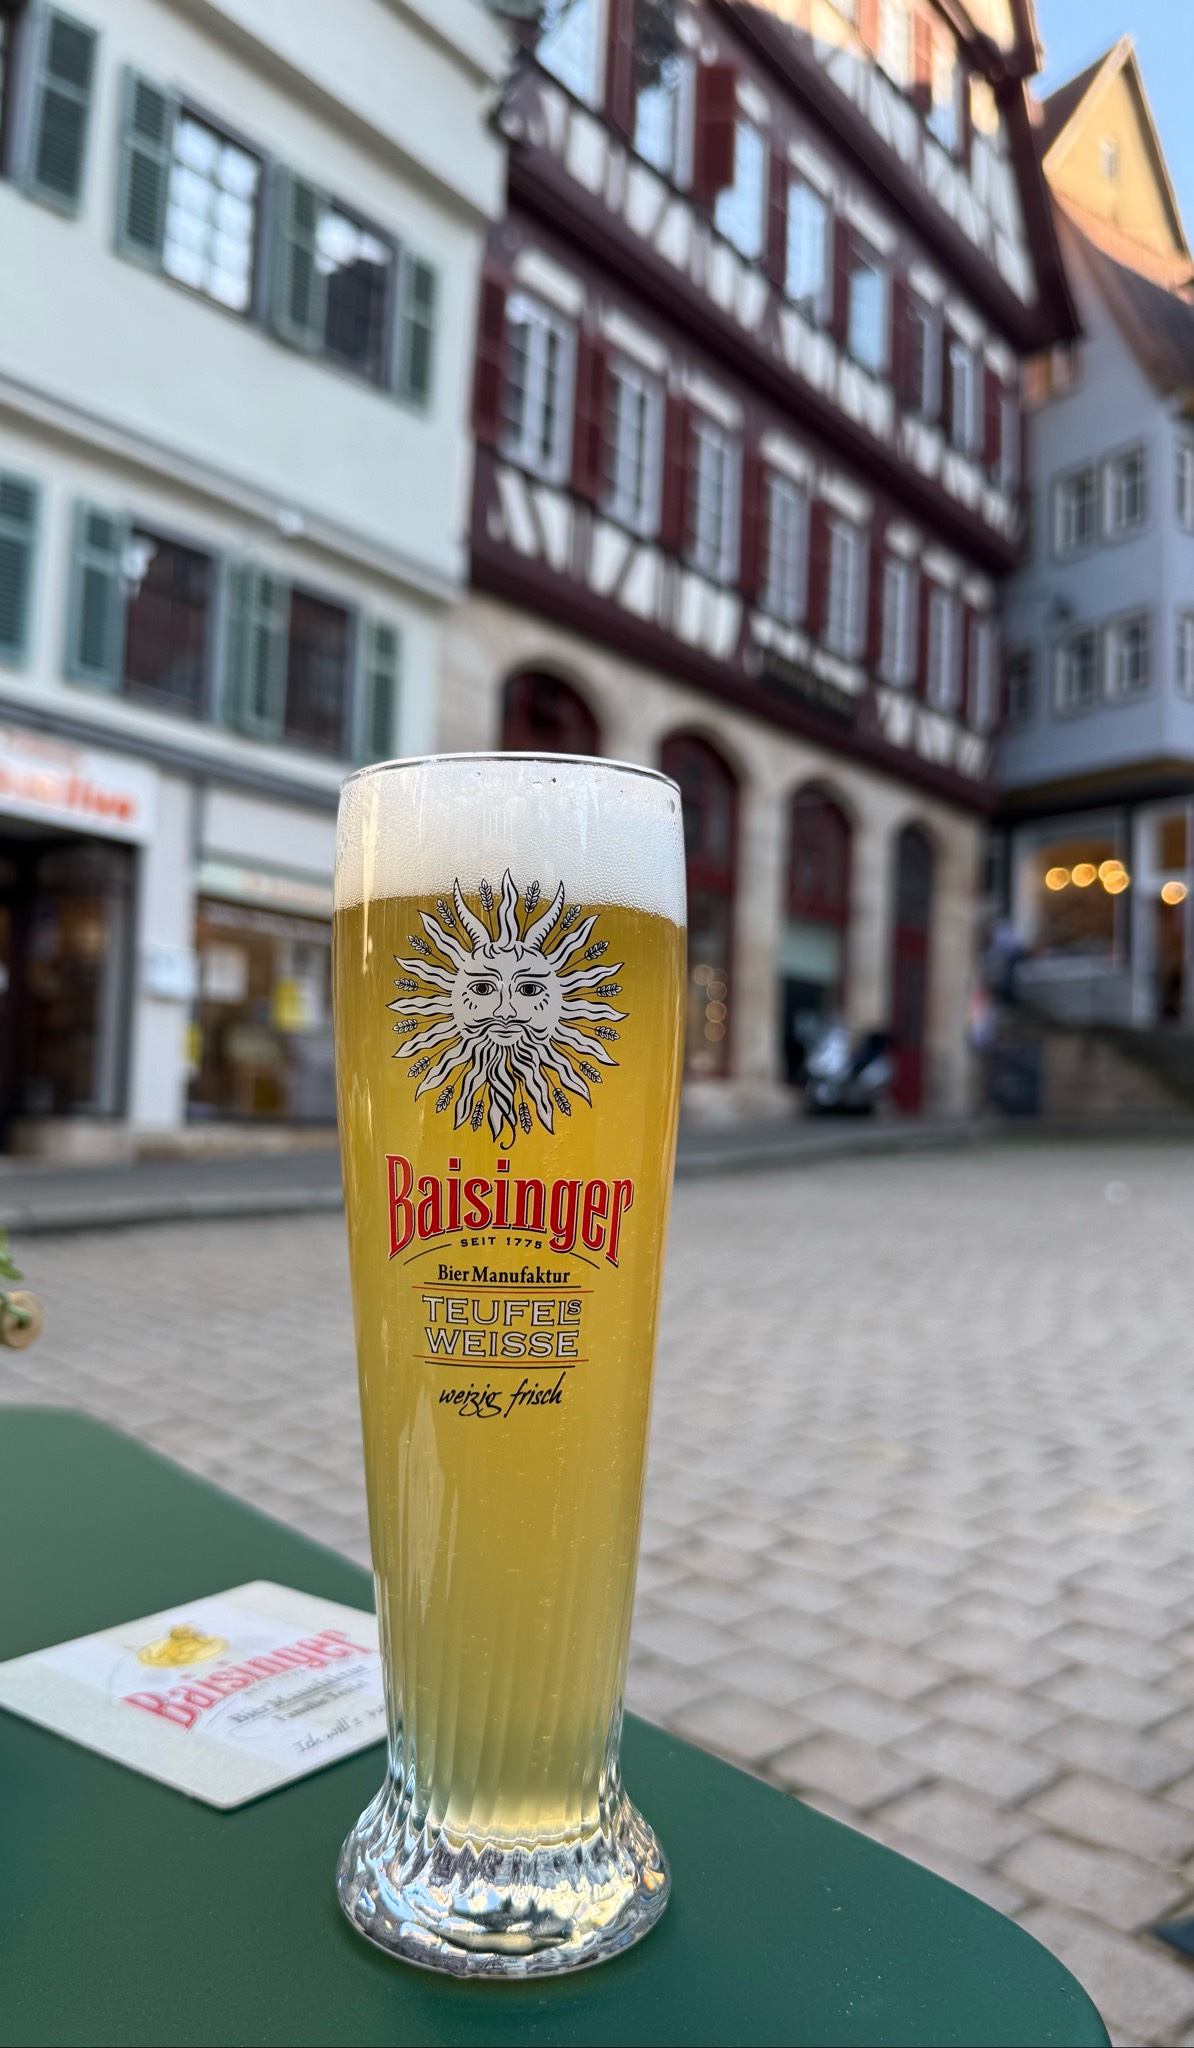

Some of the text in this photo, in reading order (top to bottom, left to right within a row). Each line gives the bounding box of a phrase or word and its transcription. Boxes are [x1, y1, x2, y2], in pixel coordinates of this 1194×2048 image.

[385, 1153, 635, 1269] Baisinger
[460, 1236, 543, 1250] SEIT 1775
[438, 1264, 571, 1284] Bier Manufaktur
[424, 1326, 580, 1358] WEISSE
[438, 1370, 567, 1419] weizig frisch
[120, 1628, 375, 1735] Baisinger
[227, 1702, 270, 1724] Bier
